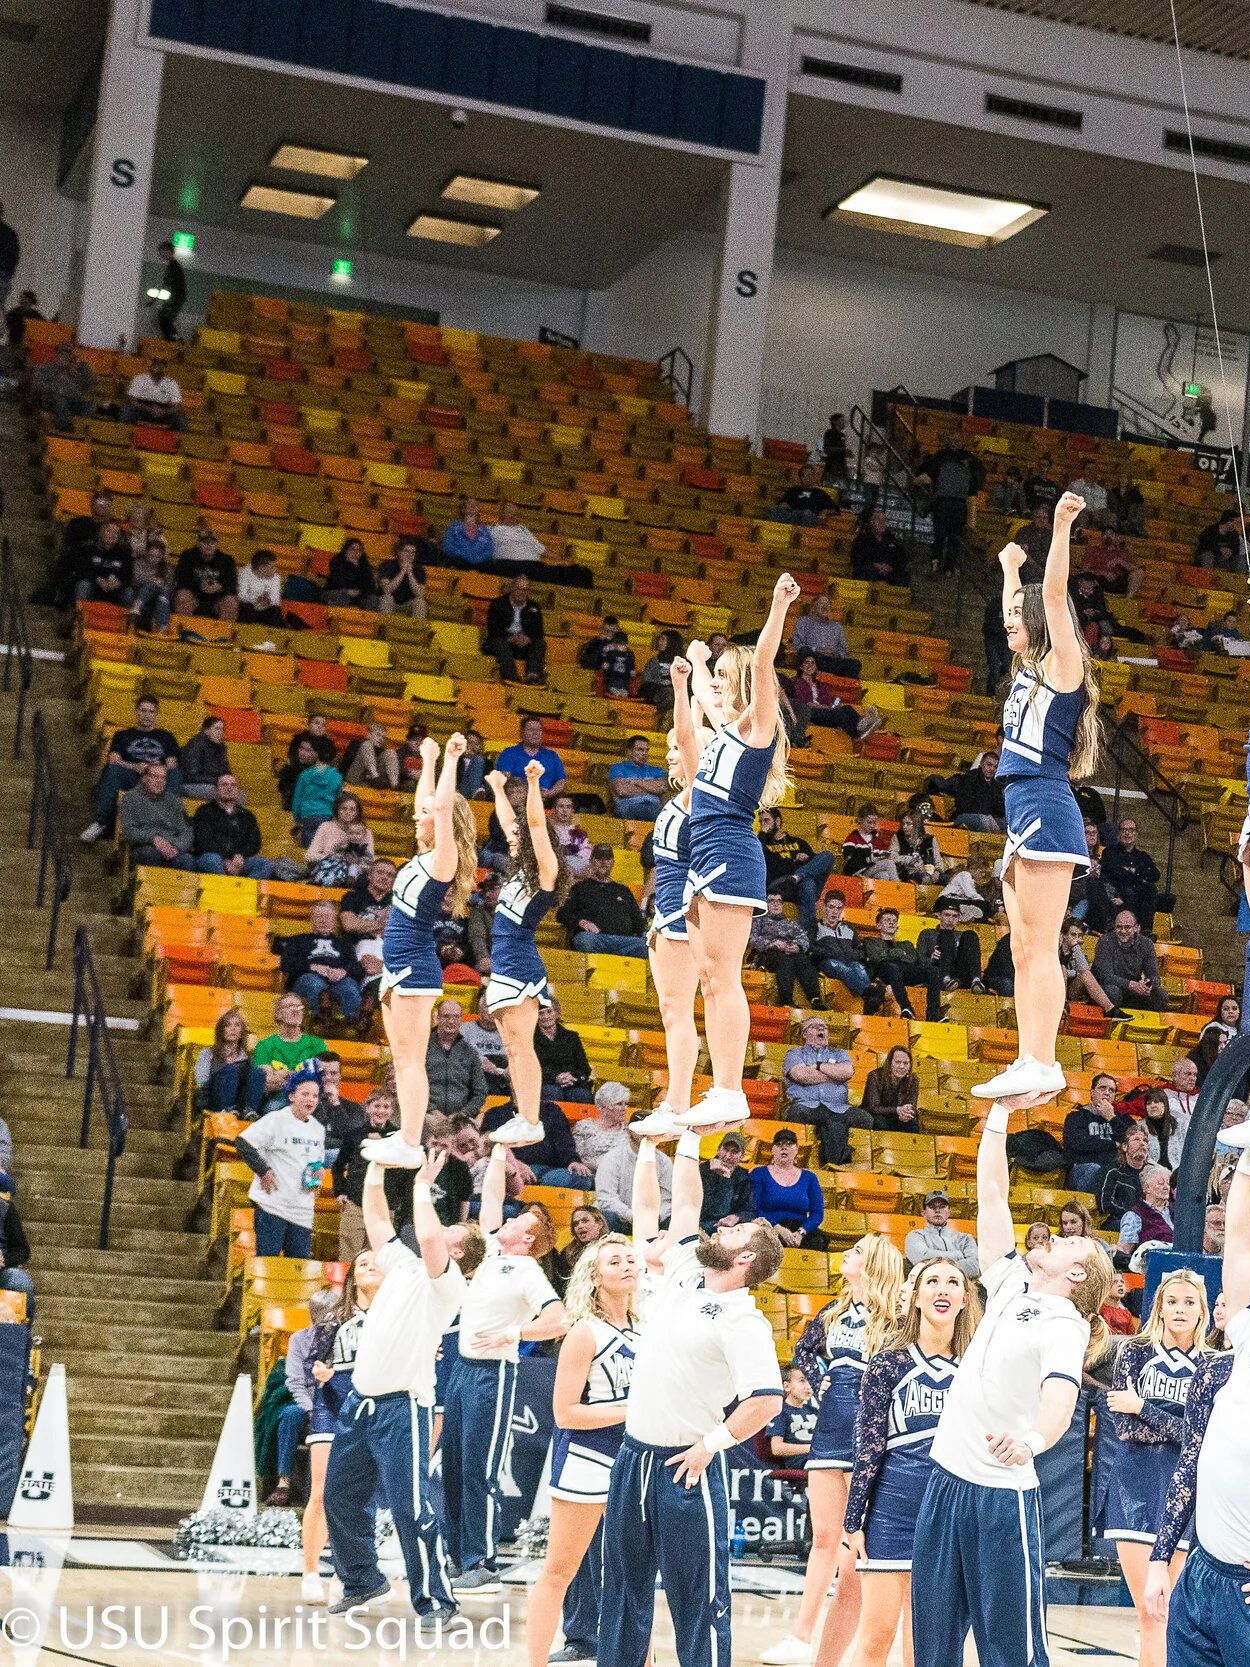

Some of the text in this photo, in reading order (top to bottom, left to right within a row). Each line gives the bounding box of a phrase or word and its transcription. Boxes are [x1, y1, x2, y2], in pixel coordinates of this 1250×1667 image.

[111, 159, 135, 187] S
[736, 271, 758, 297] S
[20, 1480, 55, 1491] STATE
[217, 1488, 252, 1499] STATE
